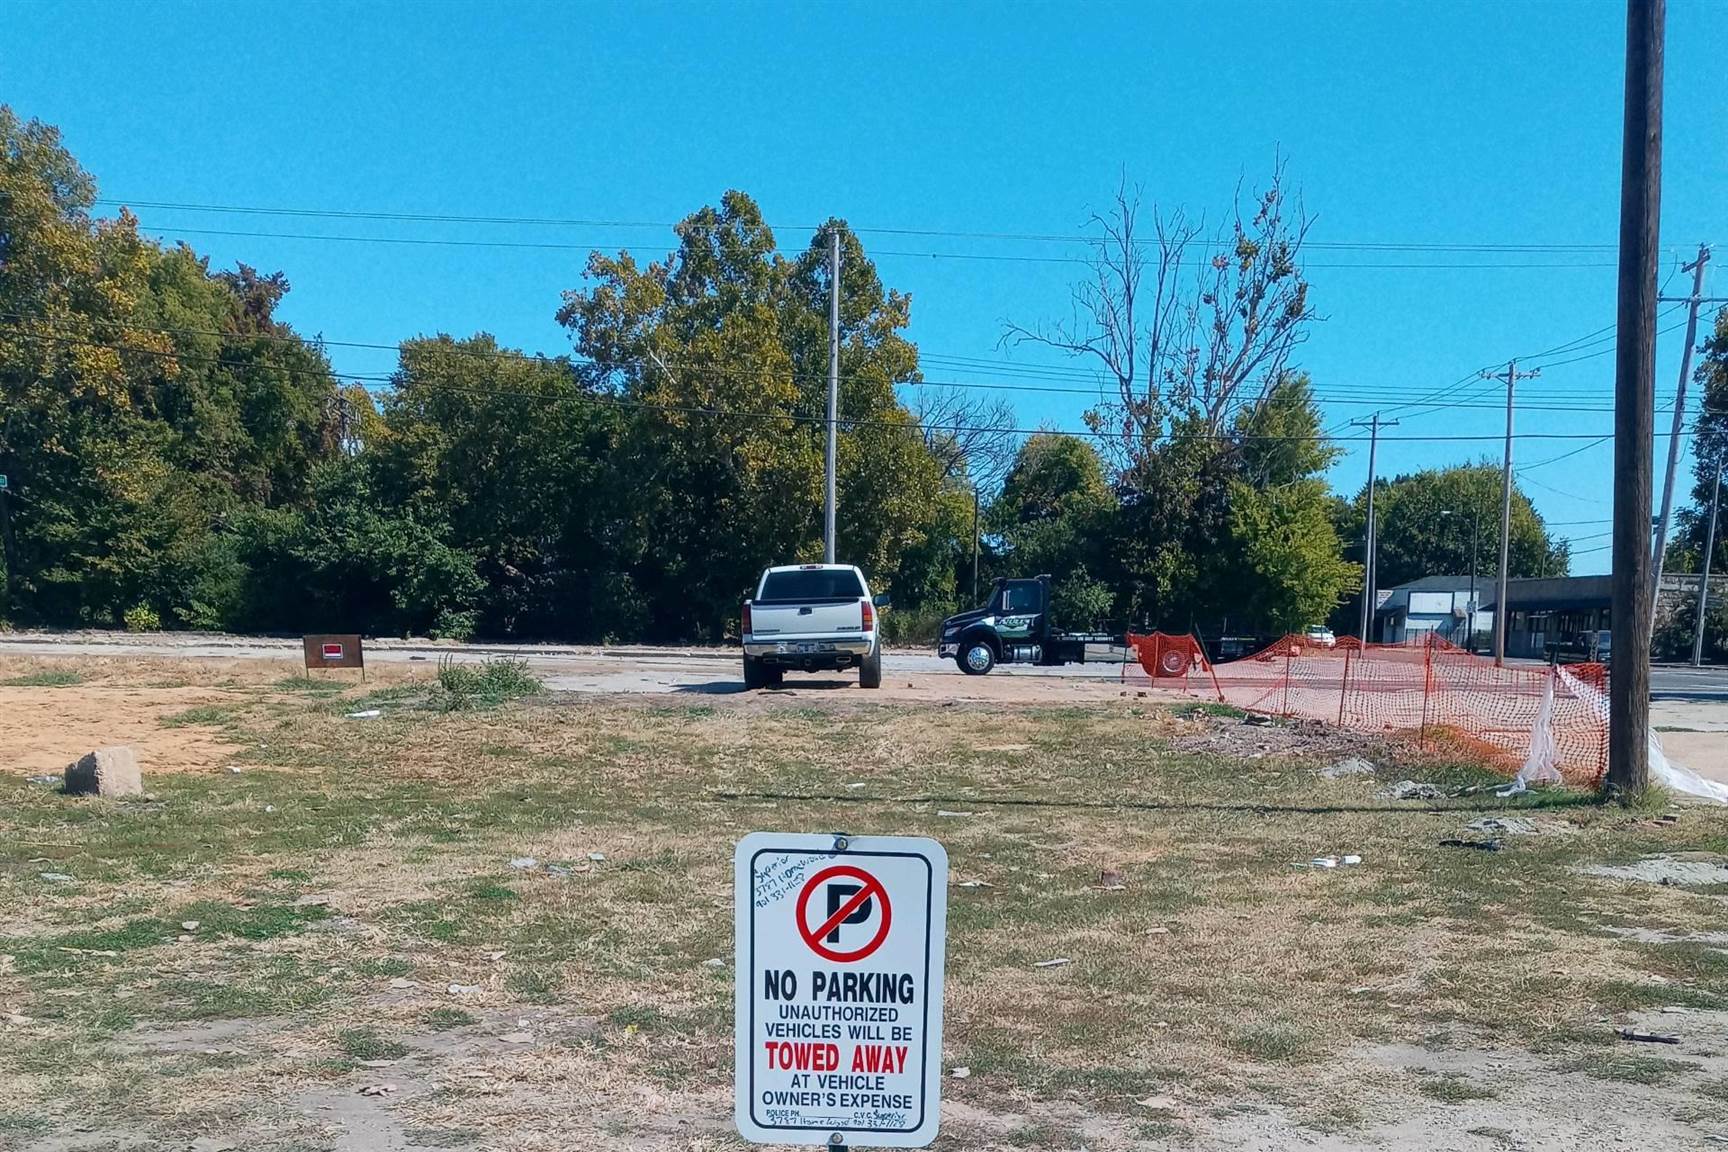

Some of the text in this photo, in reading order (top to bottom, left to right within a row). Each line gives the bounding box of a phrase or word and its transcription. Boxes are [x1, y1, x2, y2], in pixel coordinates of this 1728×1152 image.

[765, 969, 914, 1004] NO PARKING
[779, 1004, 898, 1022] UNAUTHORIZED
[765, 1023, 913, 1041] VEHICLES WILL BE
[765, 1041, 908, 1074] TOWED AWAY
[791, 1074, 885, 1091] AT VEHICLE
[762, 1091, 913, 1109] OWNER'S EXPENSE
[766, 1109, 789, 1117] POLICE
